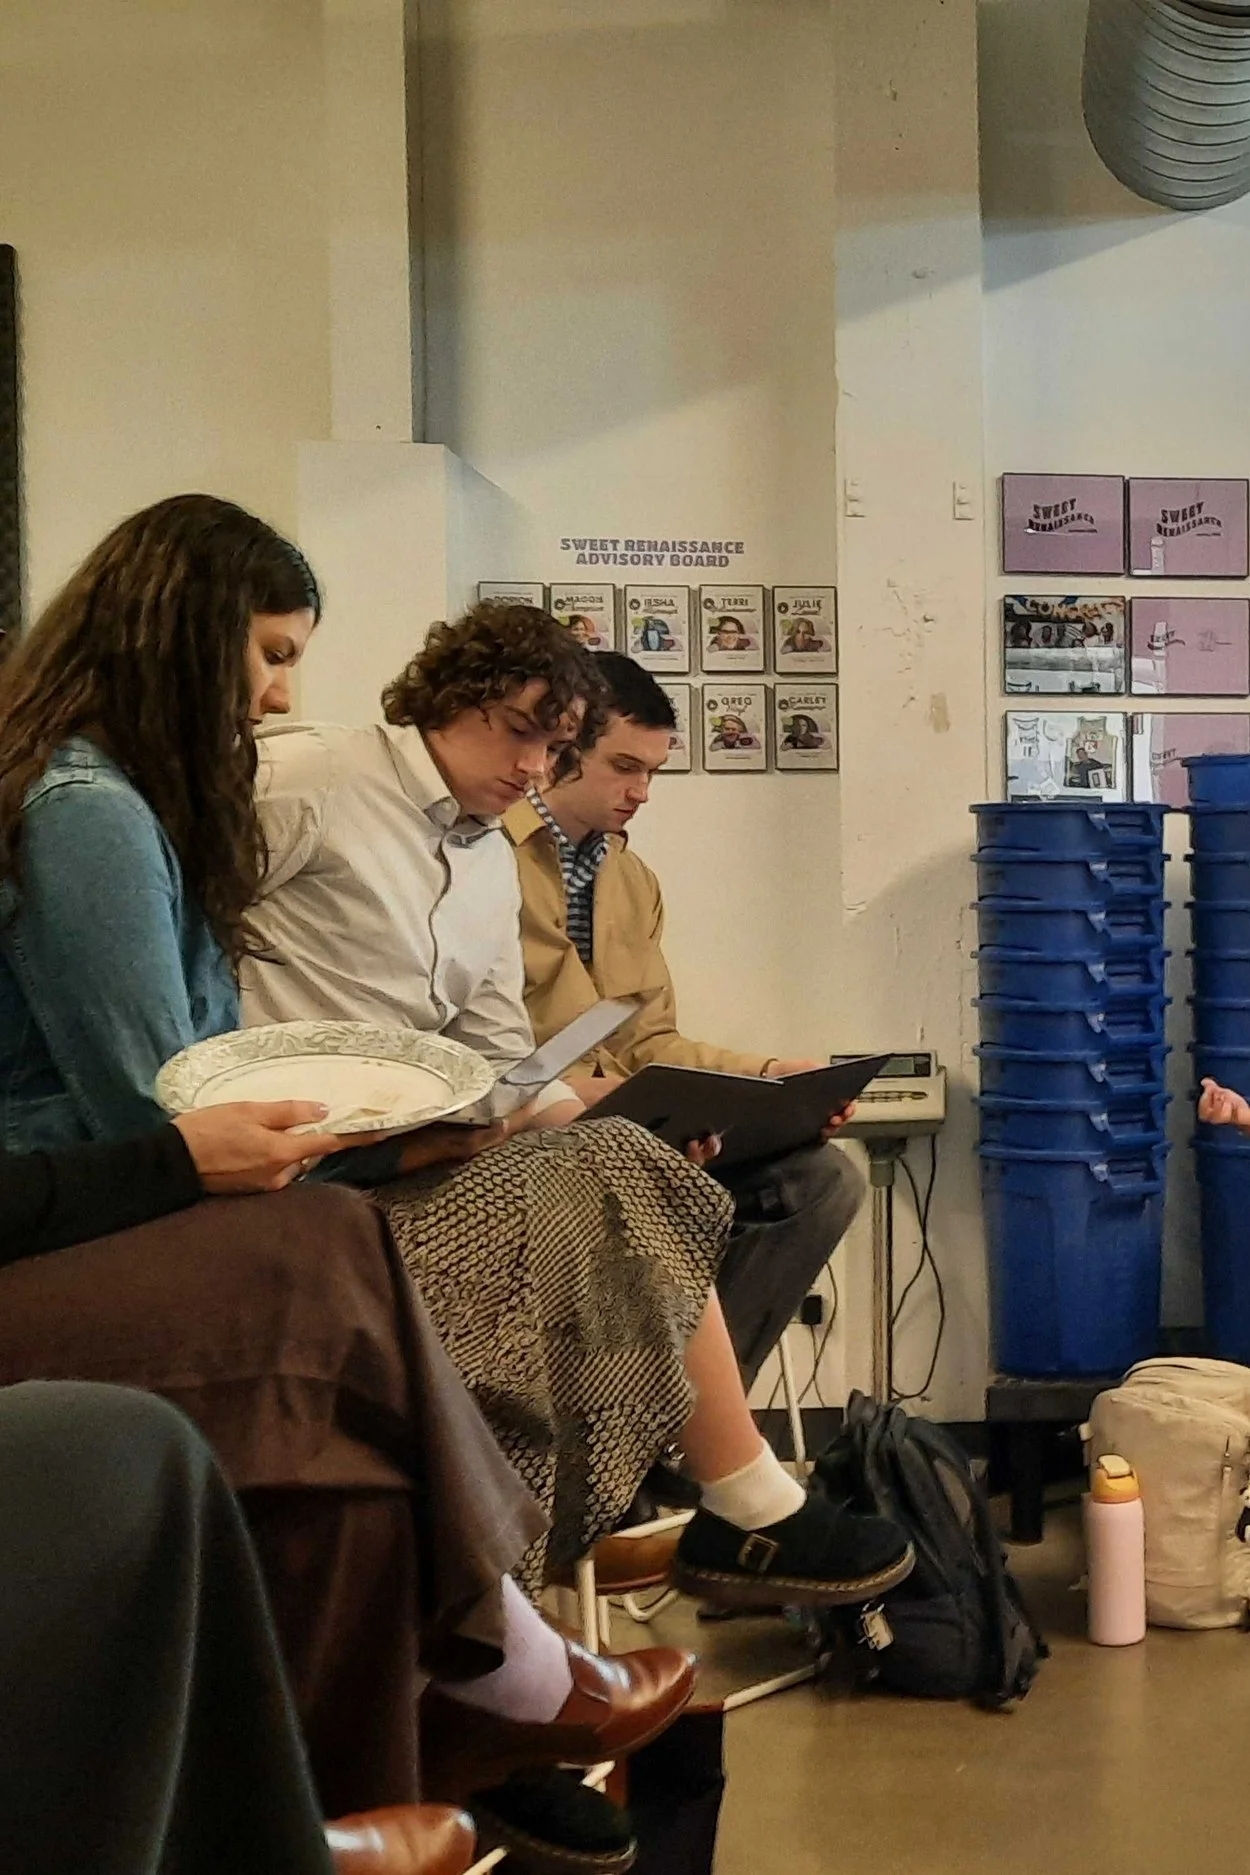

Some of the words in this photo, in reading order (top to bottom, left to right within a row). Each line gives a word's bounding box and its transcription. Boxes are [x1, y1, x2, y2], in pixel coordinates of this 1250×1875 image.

[1033, 498, 1077, 520] SWEET
[1160, 501, 1204, 524] SWEET
[559, 537, 620, 552] SWEET
[624, 539, 745, 555] RENAISSANCE
[576, 552, 665, 566] ADVISORY
[669, 554, 730, 568] BOARD
